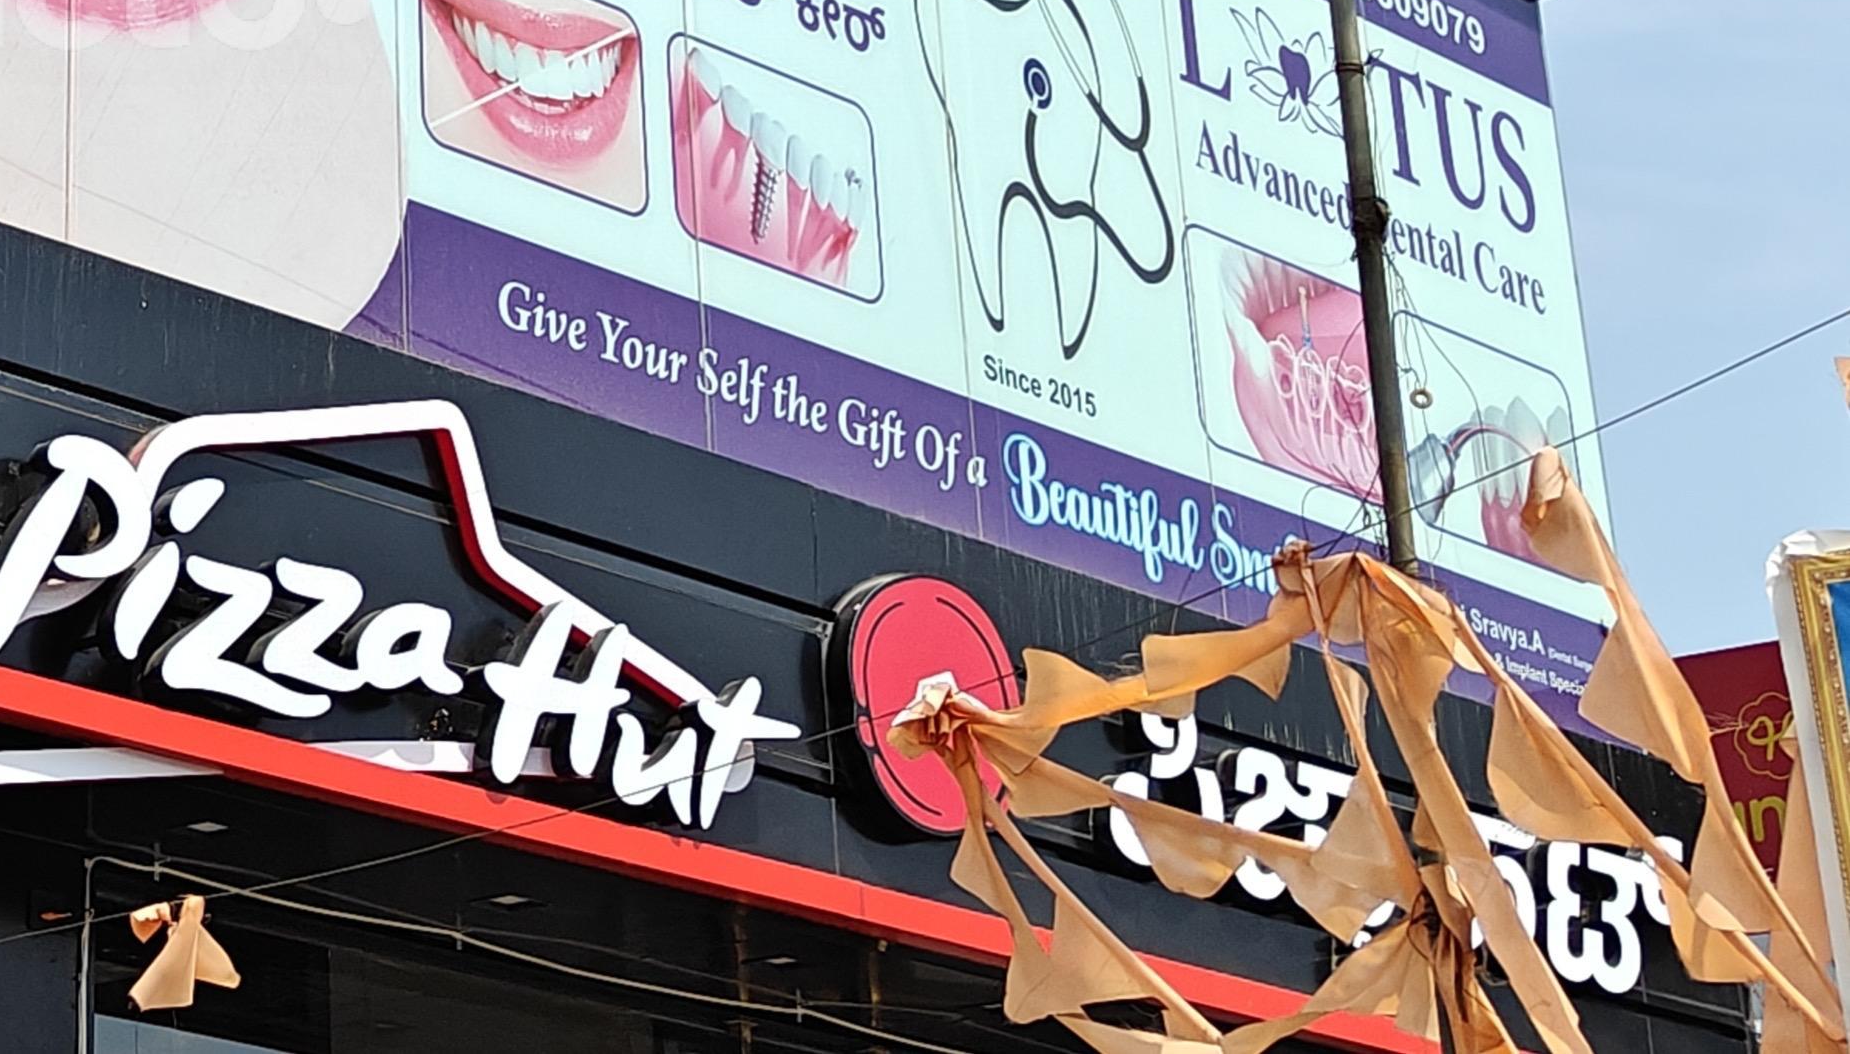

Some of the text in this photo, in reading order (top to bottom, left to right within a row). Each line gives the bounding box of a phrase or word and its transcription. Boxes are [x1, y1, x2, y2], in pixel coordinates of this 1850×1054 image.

[1196, 119, 1547, 316] Advanced ental Care
[497, 280, 588, 351] Give
[595, 310, 688, 384] Your
[696, 347, 768, 426] Self
[772, 374, 829, 432] the
[837, 397, 908, 469] Gift
[914, 423, 963, 492] Of
[966, 450, 989, 488] a
[1002, 431, 1207, 585] Beautiful
[984, 353, 1098, 417] Since 2015
[484, 599, 802, 830] Hut
[1505, 659, 1548, 686] Implant
